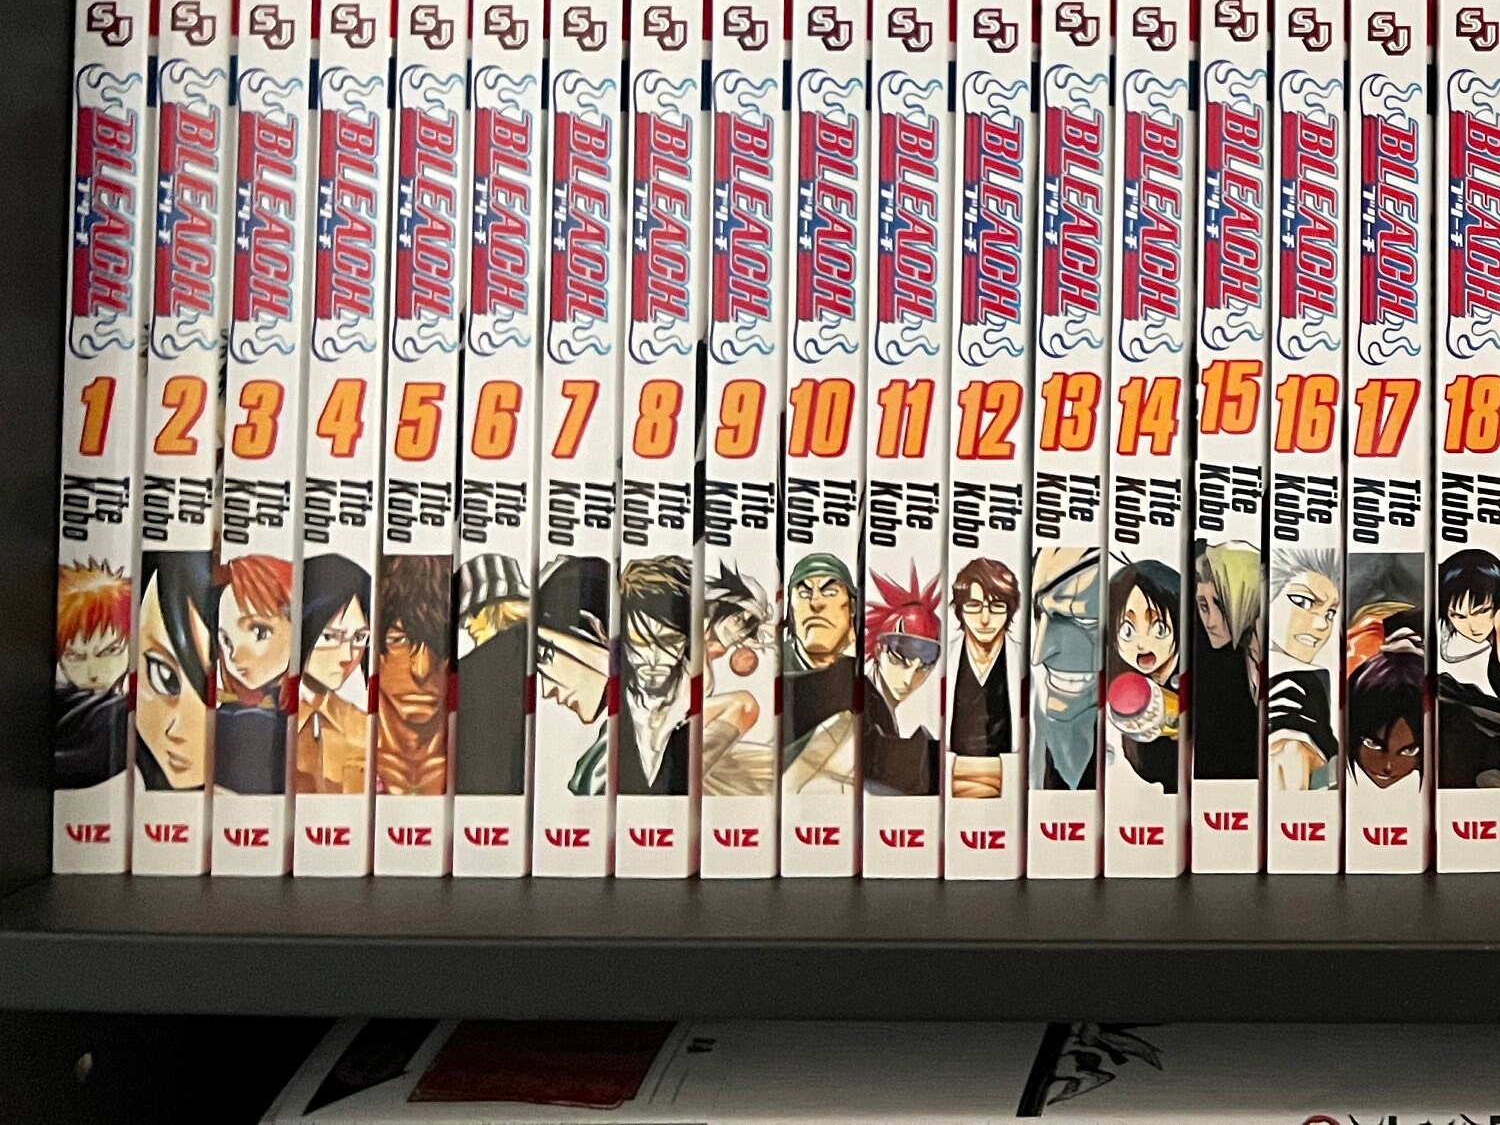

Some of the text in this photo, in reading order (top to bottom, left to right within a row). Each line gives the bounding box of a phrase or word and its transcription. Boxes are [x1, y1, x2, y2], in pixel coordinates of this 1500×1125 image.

[87, 105, 138, 312] BLEACH
[169, 103, 223, 318] BLEACH
[252, 110, 298, 320] BLEACH
[331, 108, 380, 320] BLEACH
[411, 110, 459, 320] BLEACH
[487, 110, 533, 321] BLEACH
[566, 112, 611, 321] BLEACH
[645, 112, 693, 323] BLEACH
[730, 112, 775, 321] BLEACH
[812, 111, 859, 320] BLEACH
[893, 114, 940, 321] BLEACH
[978, 114, 1025, 327] BLEACH
[1059, 108, 1105, 313] BLEACH
[1137, 114, 1185, 321] BLEACH
[1219, 103, 1265, 308] BLEACH
[1295, 114, 1340, 323] BLEACH
[1375, 114, 1419, 323] BLEACH
[82, 377, 115, 453] 1
[156, 376, 206, 455] 2
[232, 380, 283, 459] 3
[317, 379, 366, 457] 4
[395, 383, 444, 461] 5
[472, 381, 521, 459] 6
[552, 380, 599, 458] 7
[633, 380, 682, 458] 8
[715, 380, 766, 458] 9
[789, 378, 855, 457] 10
[877, 379, 934, 458] 11
[957, 380, 1023, 460] 12
[1040, 372, 1101, 451] 13
[1118, 377, 1181, 456] 14
[1200, 360, 1263, 434] 15
[1275, 374, 1339, 453] 16
[1354, 379, 1421, 457] 17
[63, 475, 87, 539] Kubo
[94, 477, 131, 525] Tite
[223, 478, 250, 544] Kubo
[256, 480, 291, 528] Tite
[386, 479, 414, 543] Kubo
[420, 481, 452, 529] Tite
[548, 479, 575, 546] Kubo
[584, 481, 615, 530] Tite
[705, 481, 735, 547] Kubo
[741, 482, 775, 531] Tite
[870, 481, 896, 547] Kubo
[906, 482, 940, 530] Tite
[1035, 472, 1061, 539] Kubo
[1067, 474, 1101, 522] Tite
[1198, 463, 1224, 530] Kubo
[1231, 466, 1262, 514] Tite
[1353, 478, 1380, 545] Kubo
[1387, 479, 1421, 527] Tite
[66, 824, 110, 843] VIZ
[145, 824, 189, 842] VIZ
[225, 828, 269, 847] VIZ
[306, 827, 350, 846] VIZ
[388, 827, 432, 846] VIZ
[465, 827, 509, 846] VIZ
[546, 828, 590, 847] VIZ
[629, 827, 673, 847] VIZ
[714, 828, 759, 847] VIZ
[795, 827, 840, 846] VIZ
[880, 829, 924, 848] VIZ
[961, 830, 1005, 850] VIZ
[1041, 823, 1085, 841] VIZ
[1120, 827, 1164, 846] VIZ
[1204, 812, 1248, 831] VIZ
[1281, 823, 1326, 841] VIZ
[1363, 827, 1408, 846] VIZ
[1453, 820, 1496, 839] VIZ
